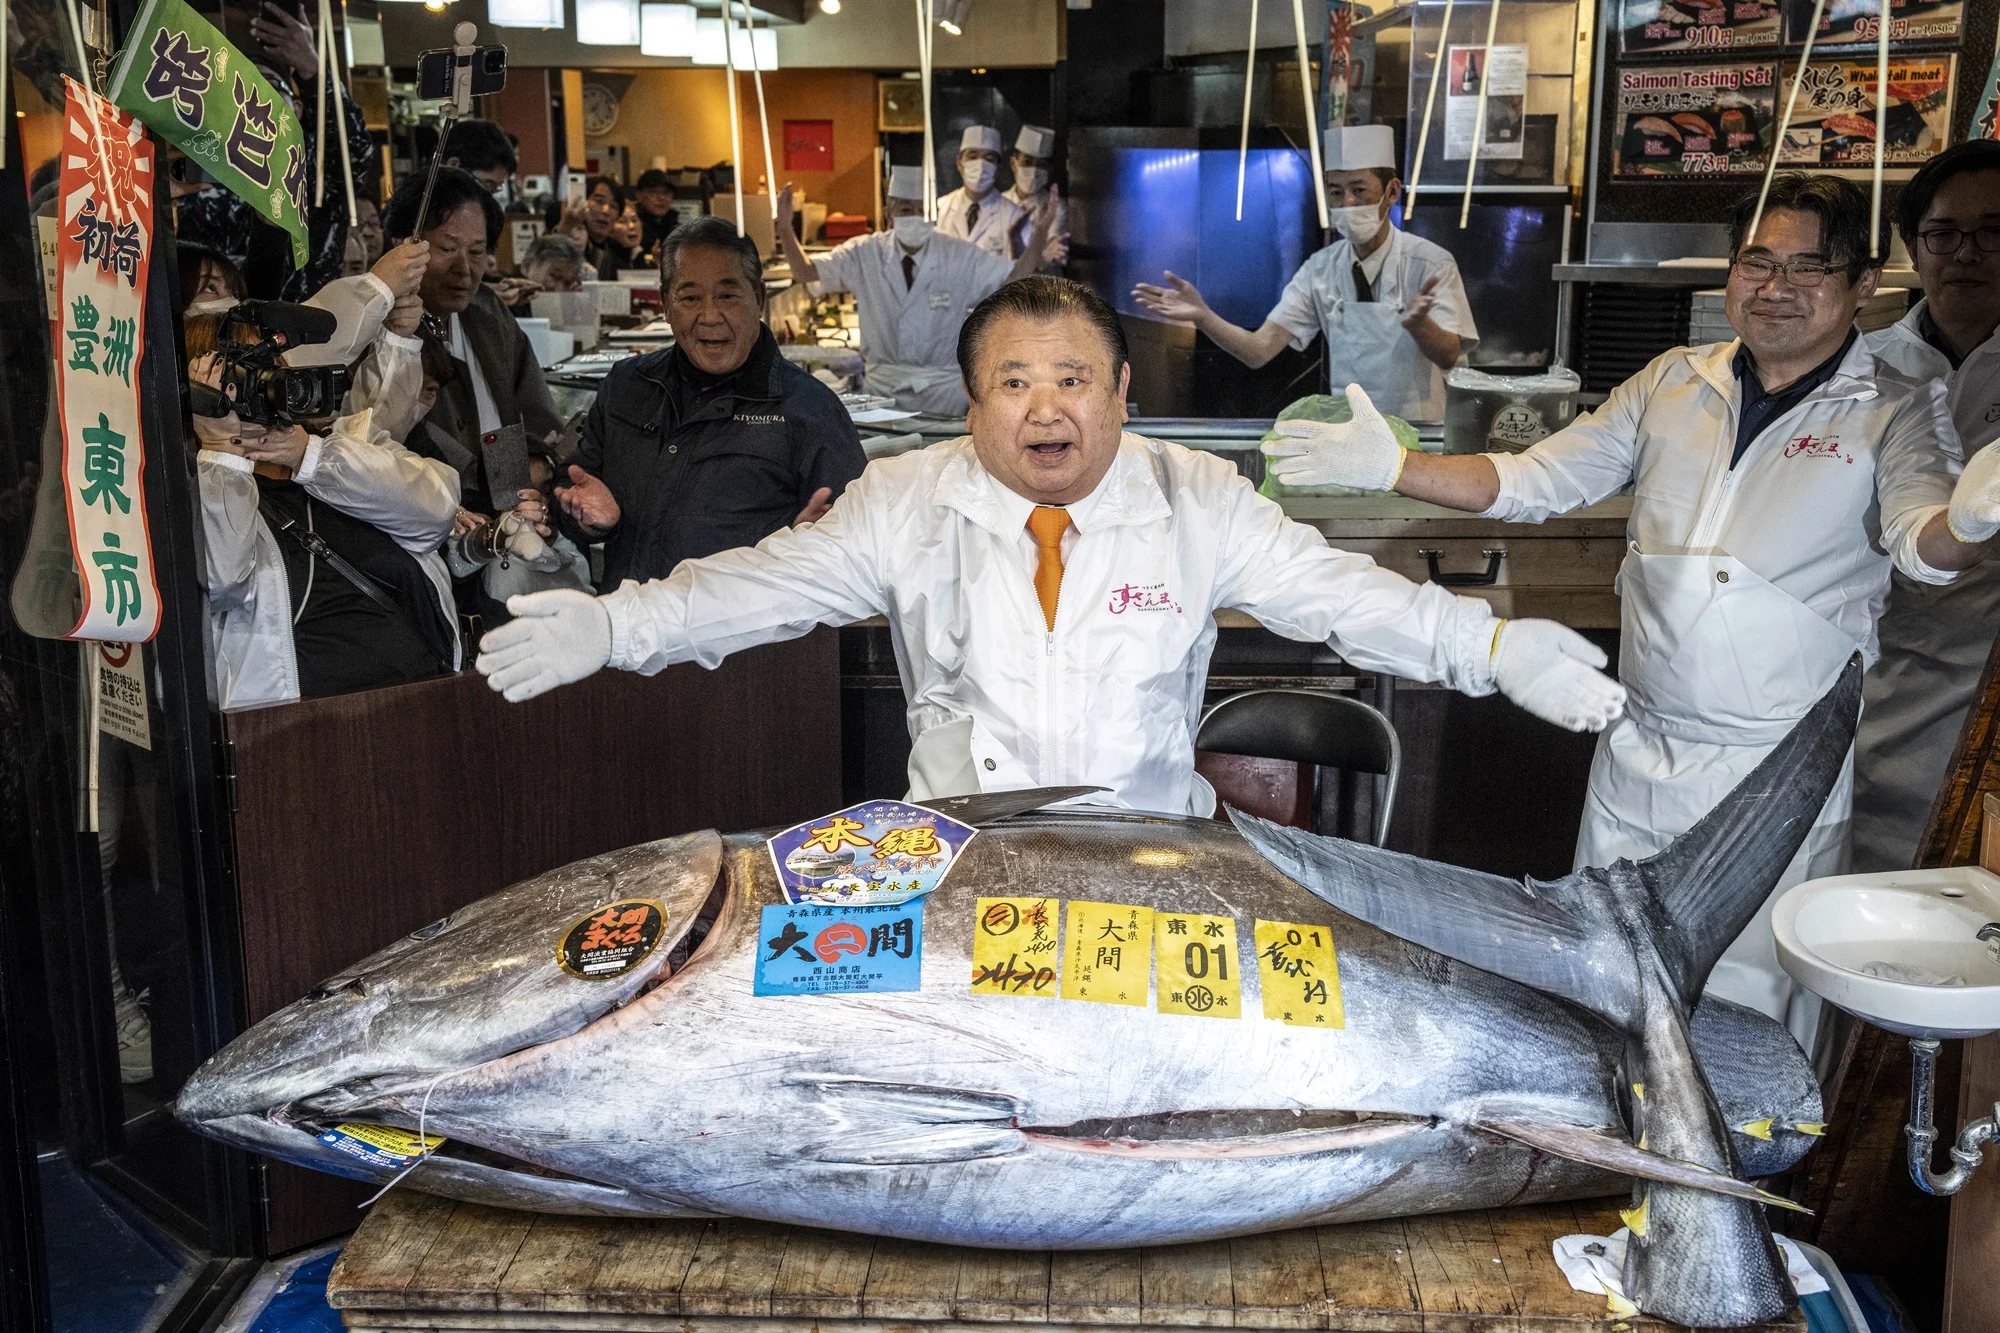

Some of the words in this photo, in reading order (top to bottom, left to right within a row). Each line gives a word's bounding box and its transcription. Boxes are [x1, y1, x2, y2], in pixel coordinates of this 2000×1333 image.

[1685, 25, 1734, 47] 910円
[1623, 73, 1678, 89] Salmon
[1682, 70, 1740, 89] Tasting
[1743, 68, 1771, 86] Set
[1850, 69, 1880, 82] Whal
[1910, 66, 1941, 81] meat
[1807, 85, 1868, 112] 尾の身
[1681, 152, 1729, 173] 773円
[66, 294, 136, 389] 豊洲
[733, 414, 785, 422] KIYOMURA
[1495, 421, 1539, 433] クッキング
[1508, 412, 1528, 422] エコ
[787, 908, 834, 918] 青森県産
[840, 905, 901, 916] 本州最北端
[1128, 910, 1139, 940] 青森県
[1096, 918, 1126, 972] 大間
[1287, 930, 1321, 947] 01
[813, 966, 861, 975] 西山商店
[1185, 942, 1227, 980] 01
